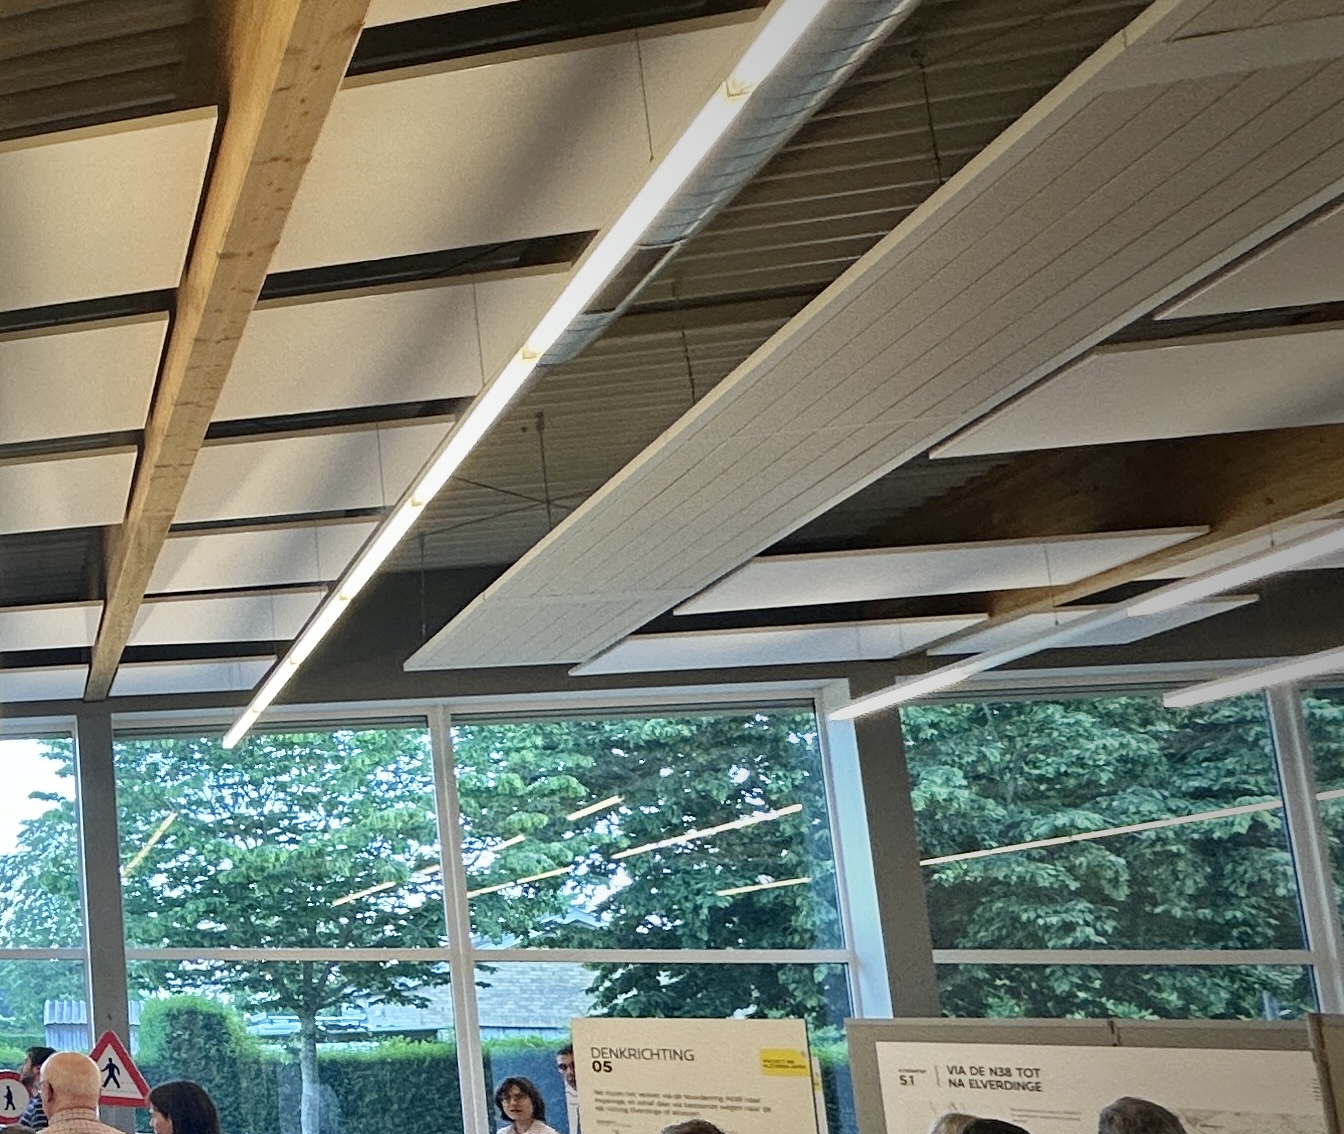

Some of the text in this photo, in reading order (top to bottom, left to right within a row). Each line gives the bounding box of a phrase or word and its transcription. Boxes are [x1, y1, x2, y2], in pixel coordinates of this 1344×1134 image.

[591, 1047, 695, 1061] DENKRICHTING
[592, 1060, 613, 1073] 05
[946, 1065, 966, 1076] VIA
[969, 1066, 986, 1077] DE
[1016, 1068, 1041, 1078] TOT
[948, 1079, 1043, 1092] NA ELVERDINGE
